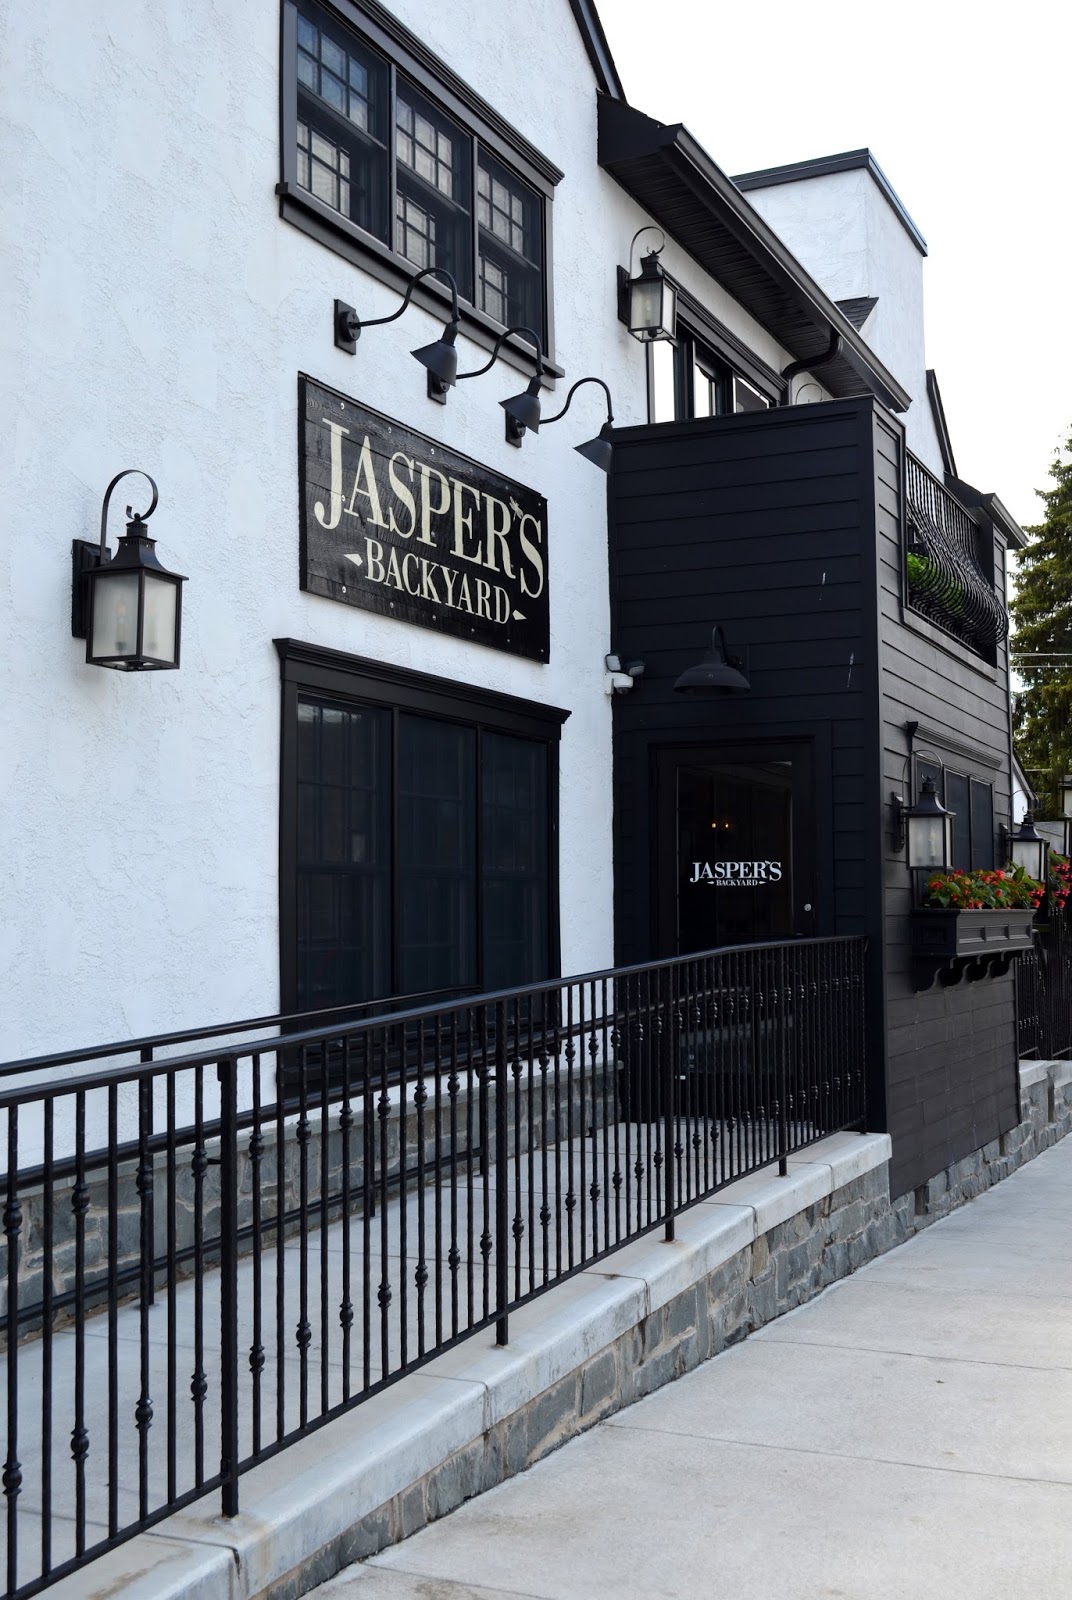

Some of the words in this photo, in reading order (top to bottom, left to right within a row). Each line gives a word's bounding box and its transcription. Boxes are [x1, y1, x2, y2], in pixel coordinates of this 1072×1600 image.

[314, 417, 544, 599] JASPER'S
[364, 537, 510, 624] BACKYARD
[689, 860, 782, 883] JASPER'S
[716, 879, 759, 887] BACKYARD
